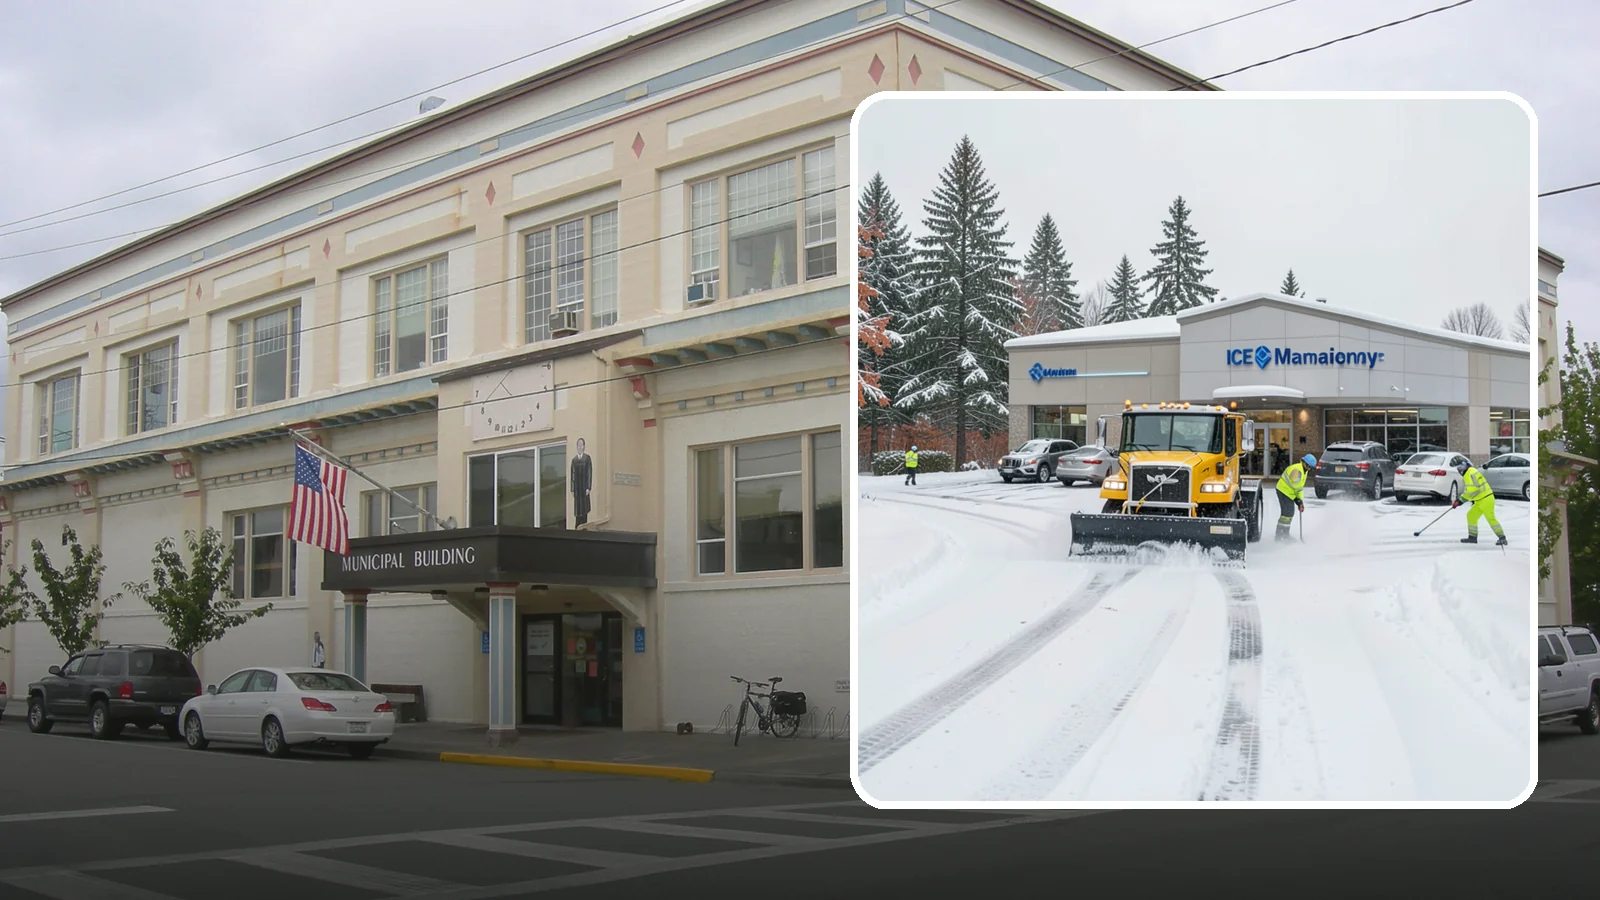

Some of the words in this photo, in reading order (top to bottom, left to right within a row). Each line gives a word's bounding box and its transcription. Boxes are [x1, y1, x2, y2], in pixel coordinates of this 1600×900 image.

[1226, 348, 1253, 366] ICE
[481, 407, 485, 415] 8
[488, 418, 492, 426] 9
[507, 425, 513, 433] 12
[521, 420, 525, 428] 2
[529, 414, 533, 422] 3
[536, 402, 540, 410] 4
[342, 552, 405, 572] MUNICIPAL
[414, 546, 475, 567] BUILDING
